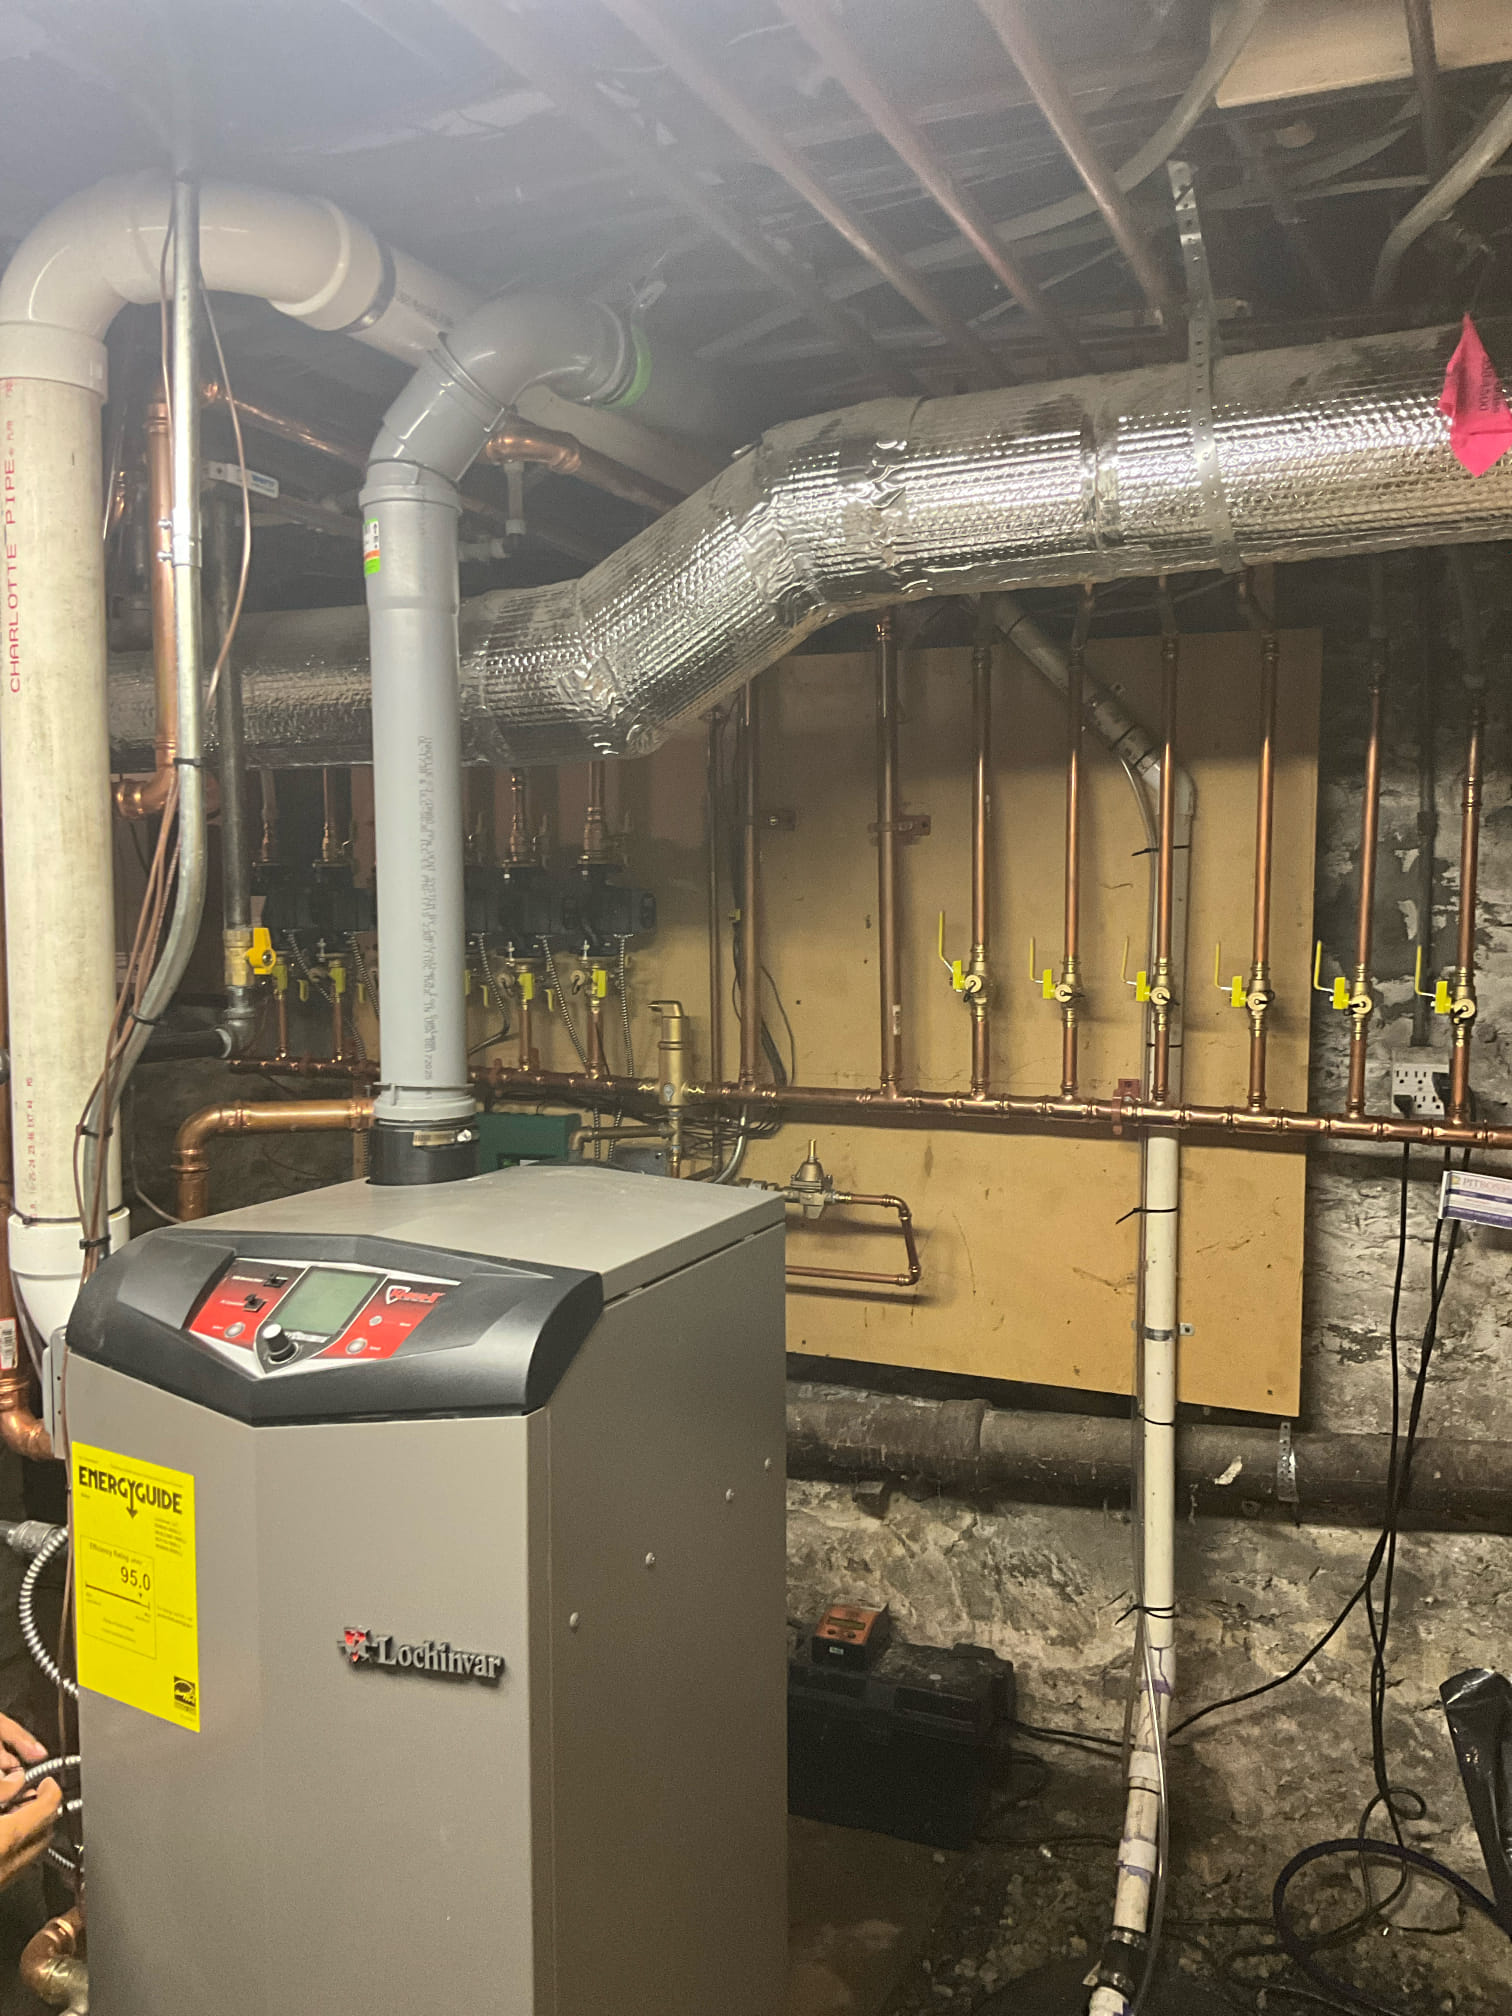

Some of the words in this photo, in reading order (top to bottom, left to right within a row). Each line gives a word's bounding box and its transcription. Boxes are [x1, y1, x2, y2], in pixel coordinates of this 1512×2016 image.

[4, 459, 17, 526] PIPE
[7, 544, 21, 693] CHARLOTTE
[79, 1466, 182, 1515] ENERGYGUIDE
[120, 1566, 151, 1591] 95.0
[377, 1636, 504, 1679] Lochinvar
